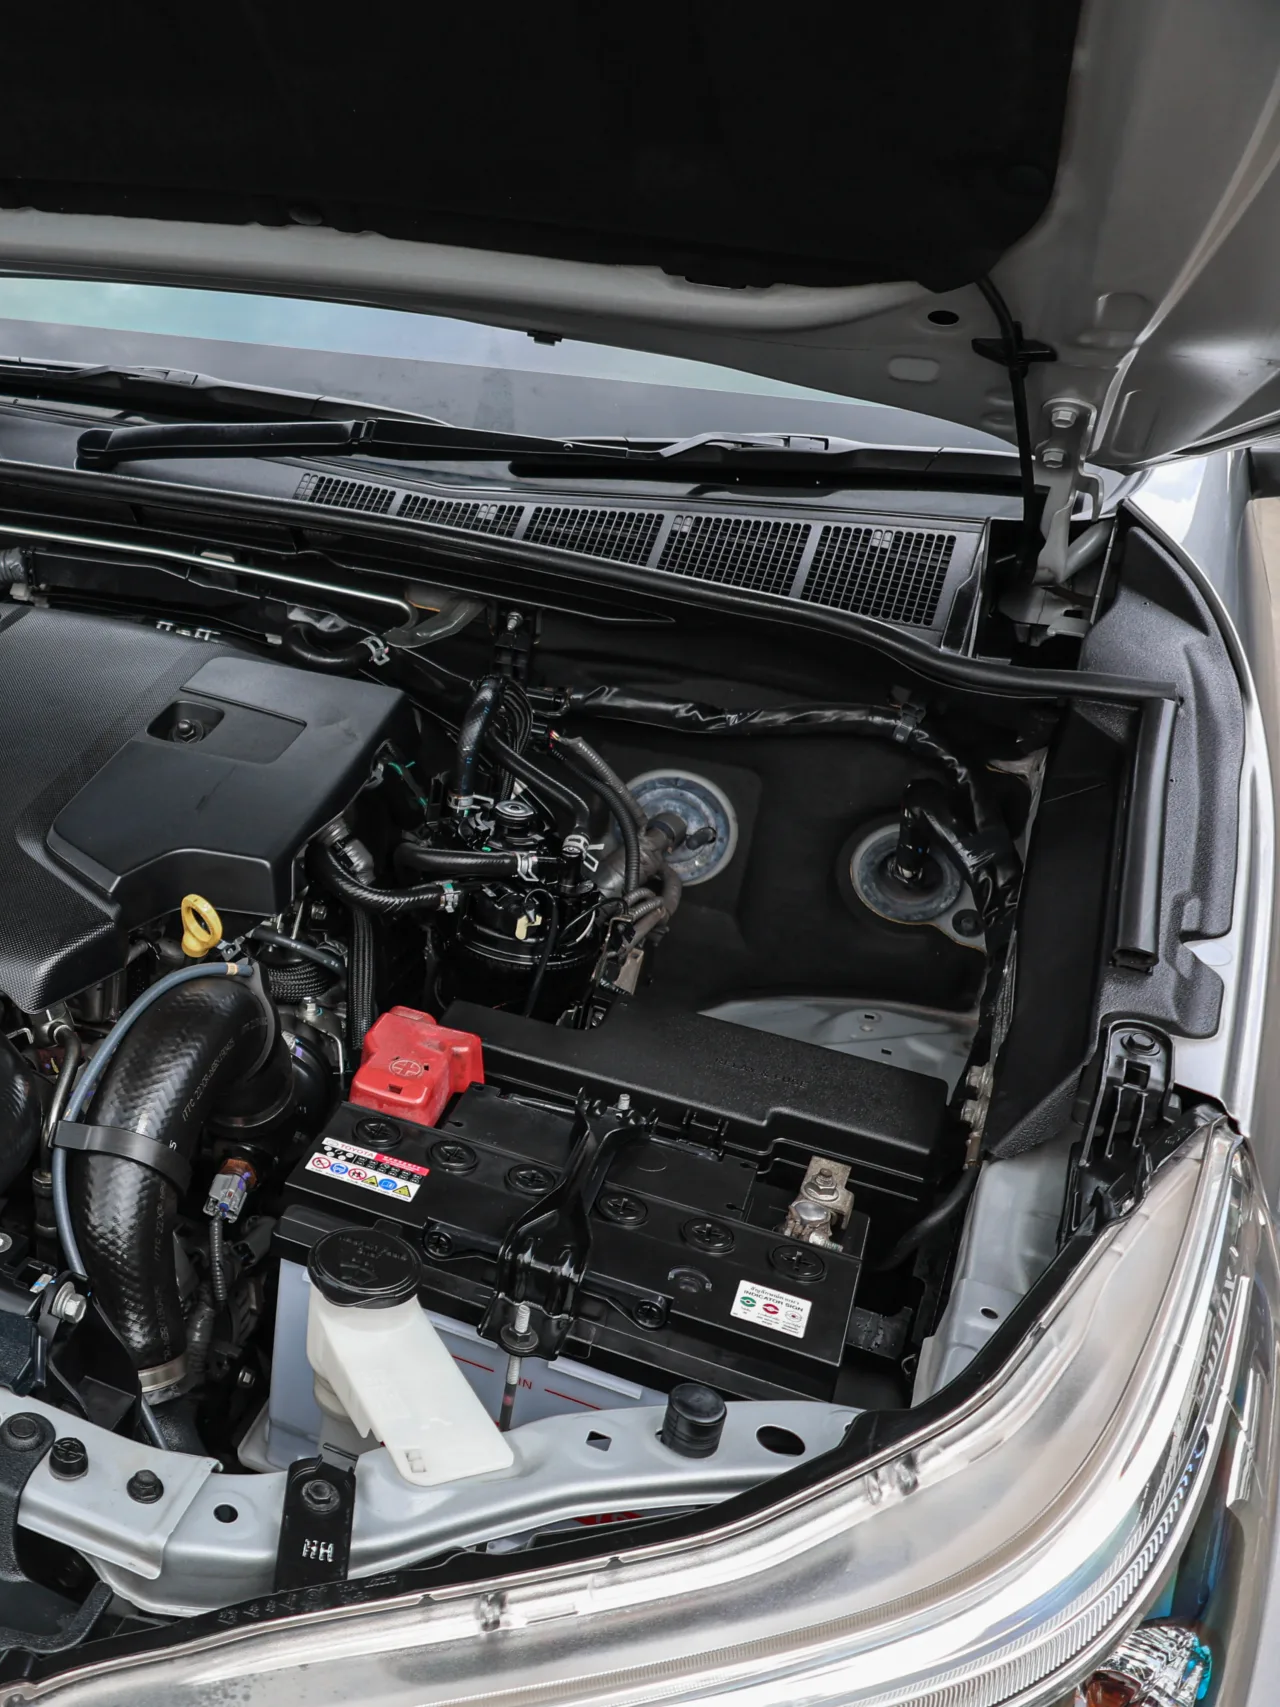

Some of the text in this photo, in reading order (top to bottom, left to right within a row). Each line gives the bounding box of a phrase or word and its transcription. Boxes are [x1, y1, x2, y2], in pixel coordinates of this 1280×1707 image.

[339, 1143, 375, 1158] TOYOTA
[743, 1290, 804, 1312] INDICATOR SIGN
